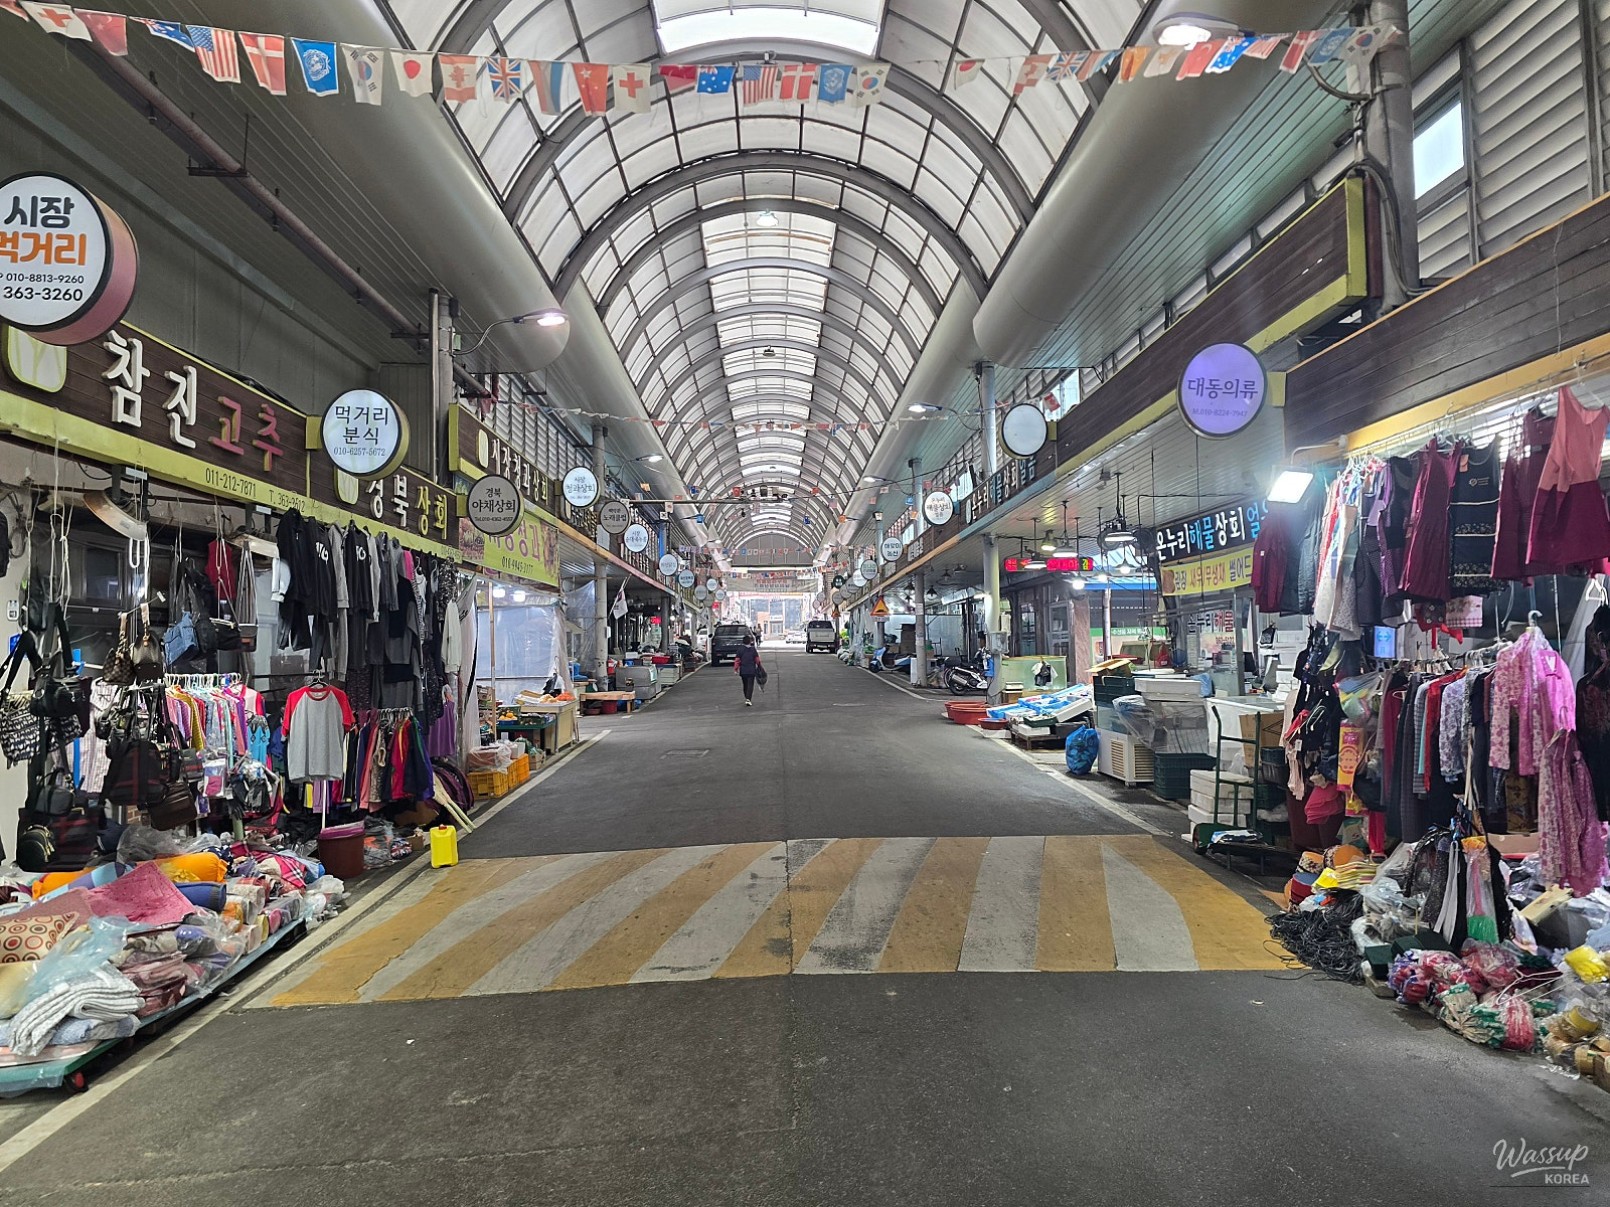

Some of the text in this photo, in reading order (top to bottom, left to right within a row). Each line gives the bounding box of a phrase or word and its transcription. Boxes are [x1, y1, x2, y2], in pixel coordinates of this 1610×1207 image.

[4, 195, 75, 229] 시장
[6, 272, 84, 284] 010-8813-9260
[3, 286, 84, 301] 363-3260
[1188, 377, 1258, 399] 대동의류
[335, 405, 388, 426] 먹거리
[343, 426, 379, 446] 분식
[205, 467, 257, 500] 011-212-7871
[485, 487, 502, 498] 경북
[471, 499, 516, 513] 야채상회
[1156, 506, 1246, 561] 온누리해물상회
